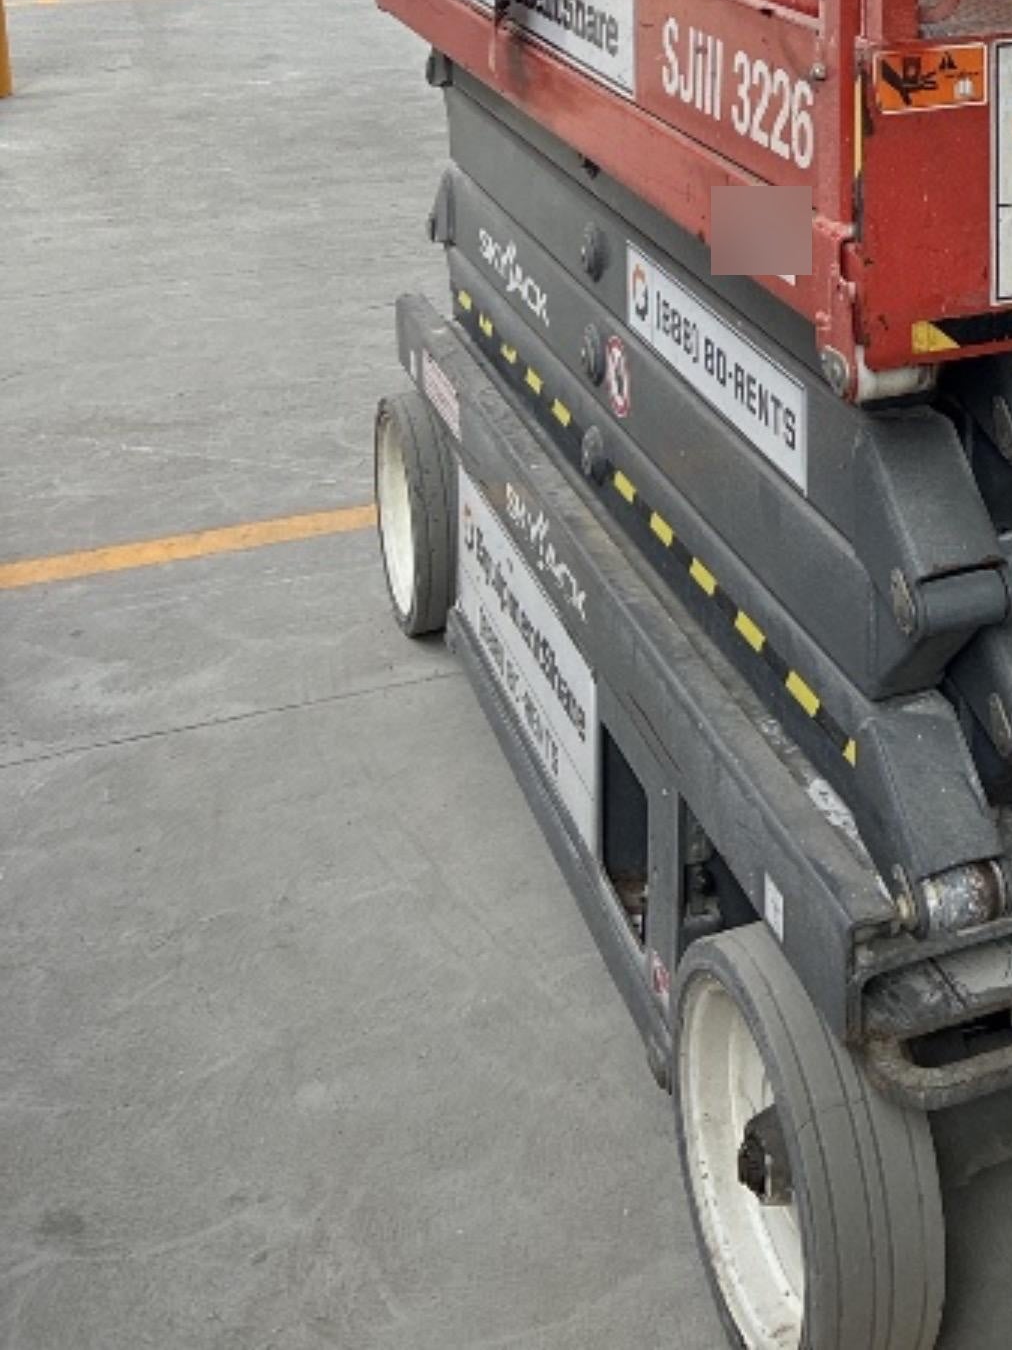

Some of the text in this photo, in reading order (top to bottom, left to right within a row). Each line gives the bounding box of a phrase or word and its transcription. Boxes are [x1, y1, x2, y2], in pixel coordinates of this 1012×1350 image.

[661, 16, 815, 170] SJill 3226
[479, 227, 550, 328] SKYJACK
[703, 334, 797, 452] 80-RENTS
